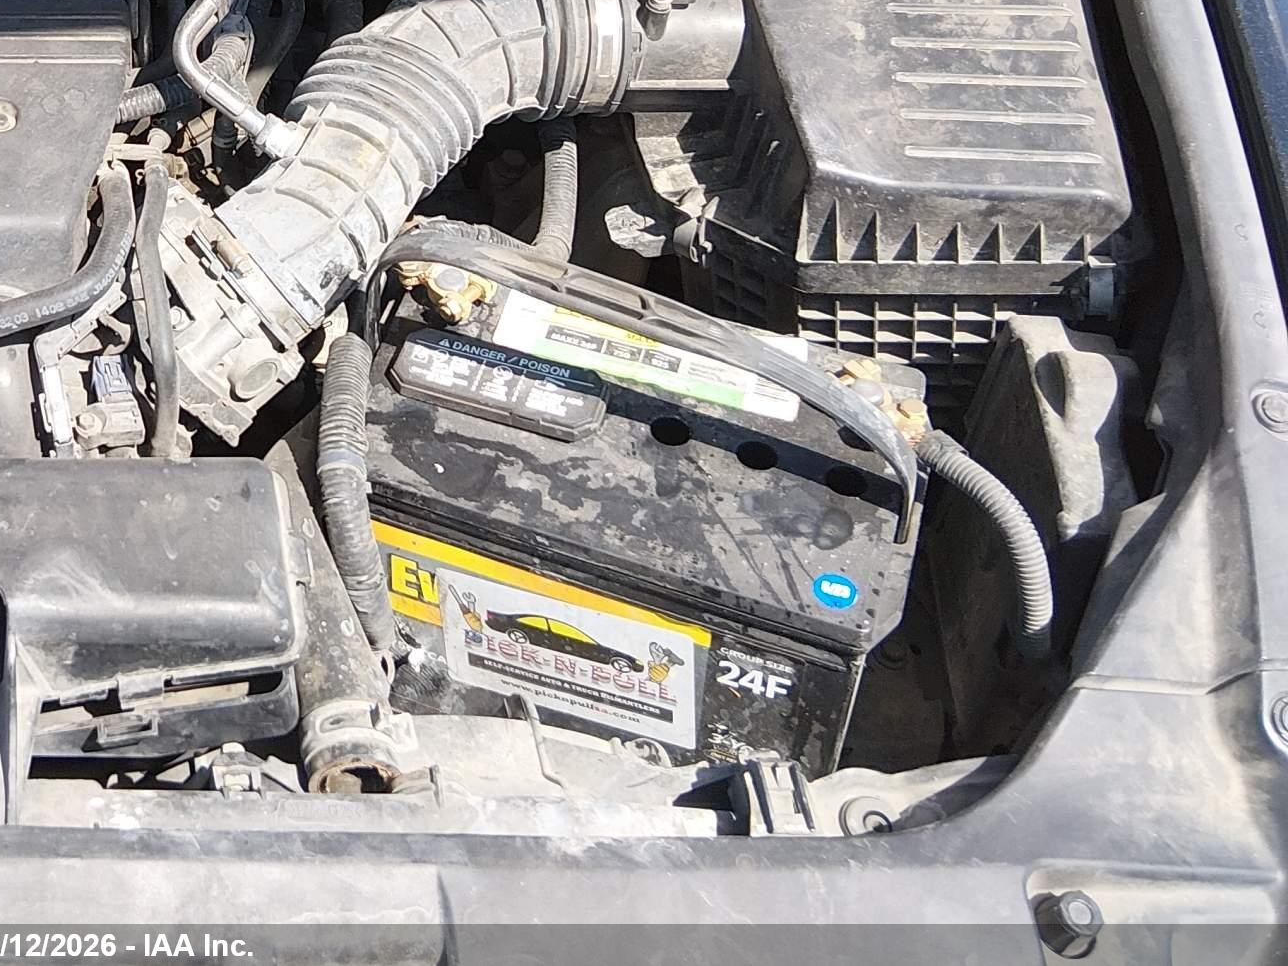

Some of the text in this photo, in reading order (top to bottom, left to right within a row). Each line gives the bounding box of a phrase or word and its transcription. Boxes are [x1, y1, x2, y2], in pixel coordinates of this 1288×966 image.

[452, 341, 507, 362] DANGER
[518, 358, 571, 378] POISON
[483, 659, 540, 680] SELF-SERVICE
[540, 676, 563, 686] AUTO
[571, 684, 599, 698] TRUCK
[716, 660, 792, 699] 24F
[720, 647, 794, 674] GROUP SIZE
